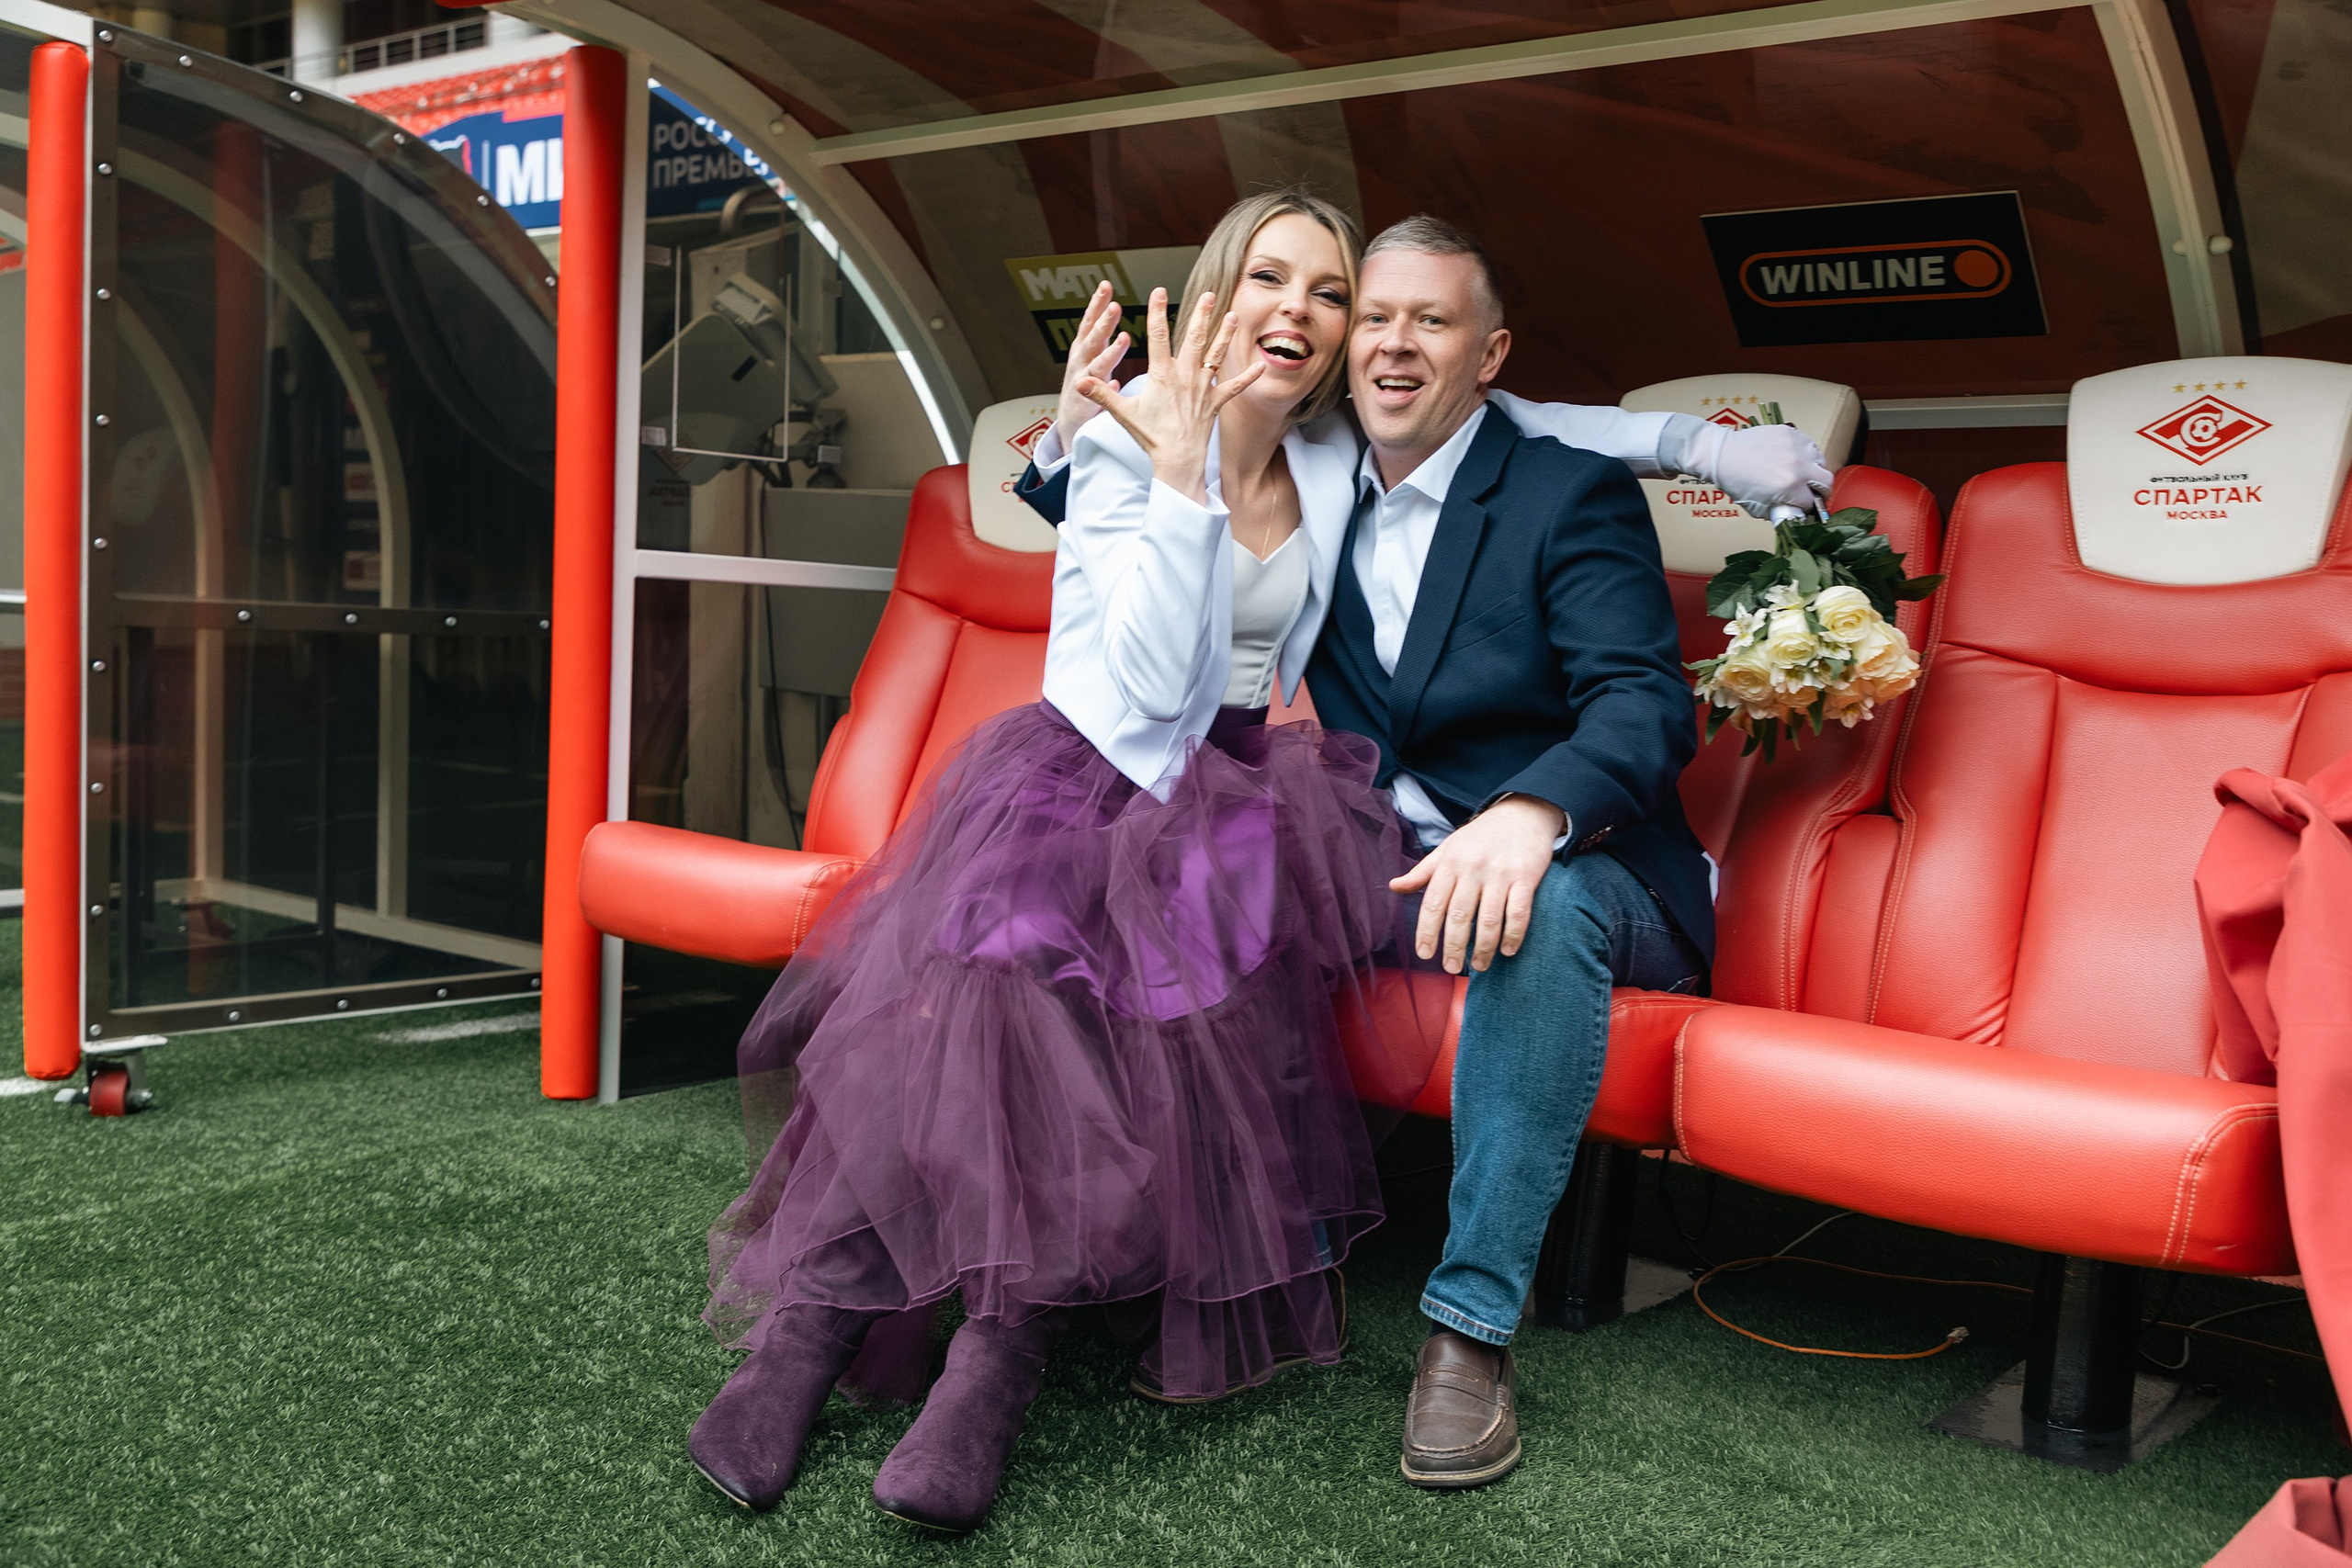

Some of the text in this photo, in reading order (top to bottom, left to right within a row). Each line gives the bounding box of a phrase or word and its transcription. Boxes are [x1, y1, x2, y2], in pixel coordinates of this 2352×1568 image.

[1760, 255, 1945, 295] WINLINE
[2134, 486, 2262, 505] СПАРТАК
[1691, 510, 1739, 518] МОСКВА
[2165, 510, 2228, 520] МОСКВА
